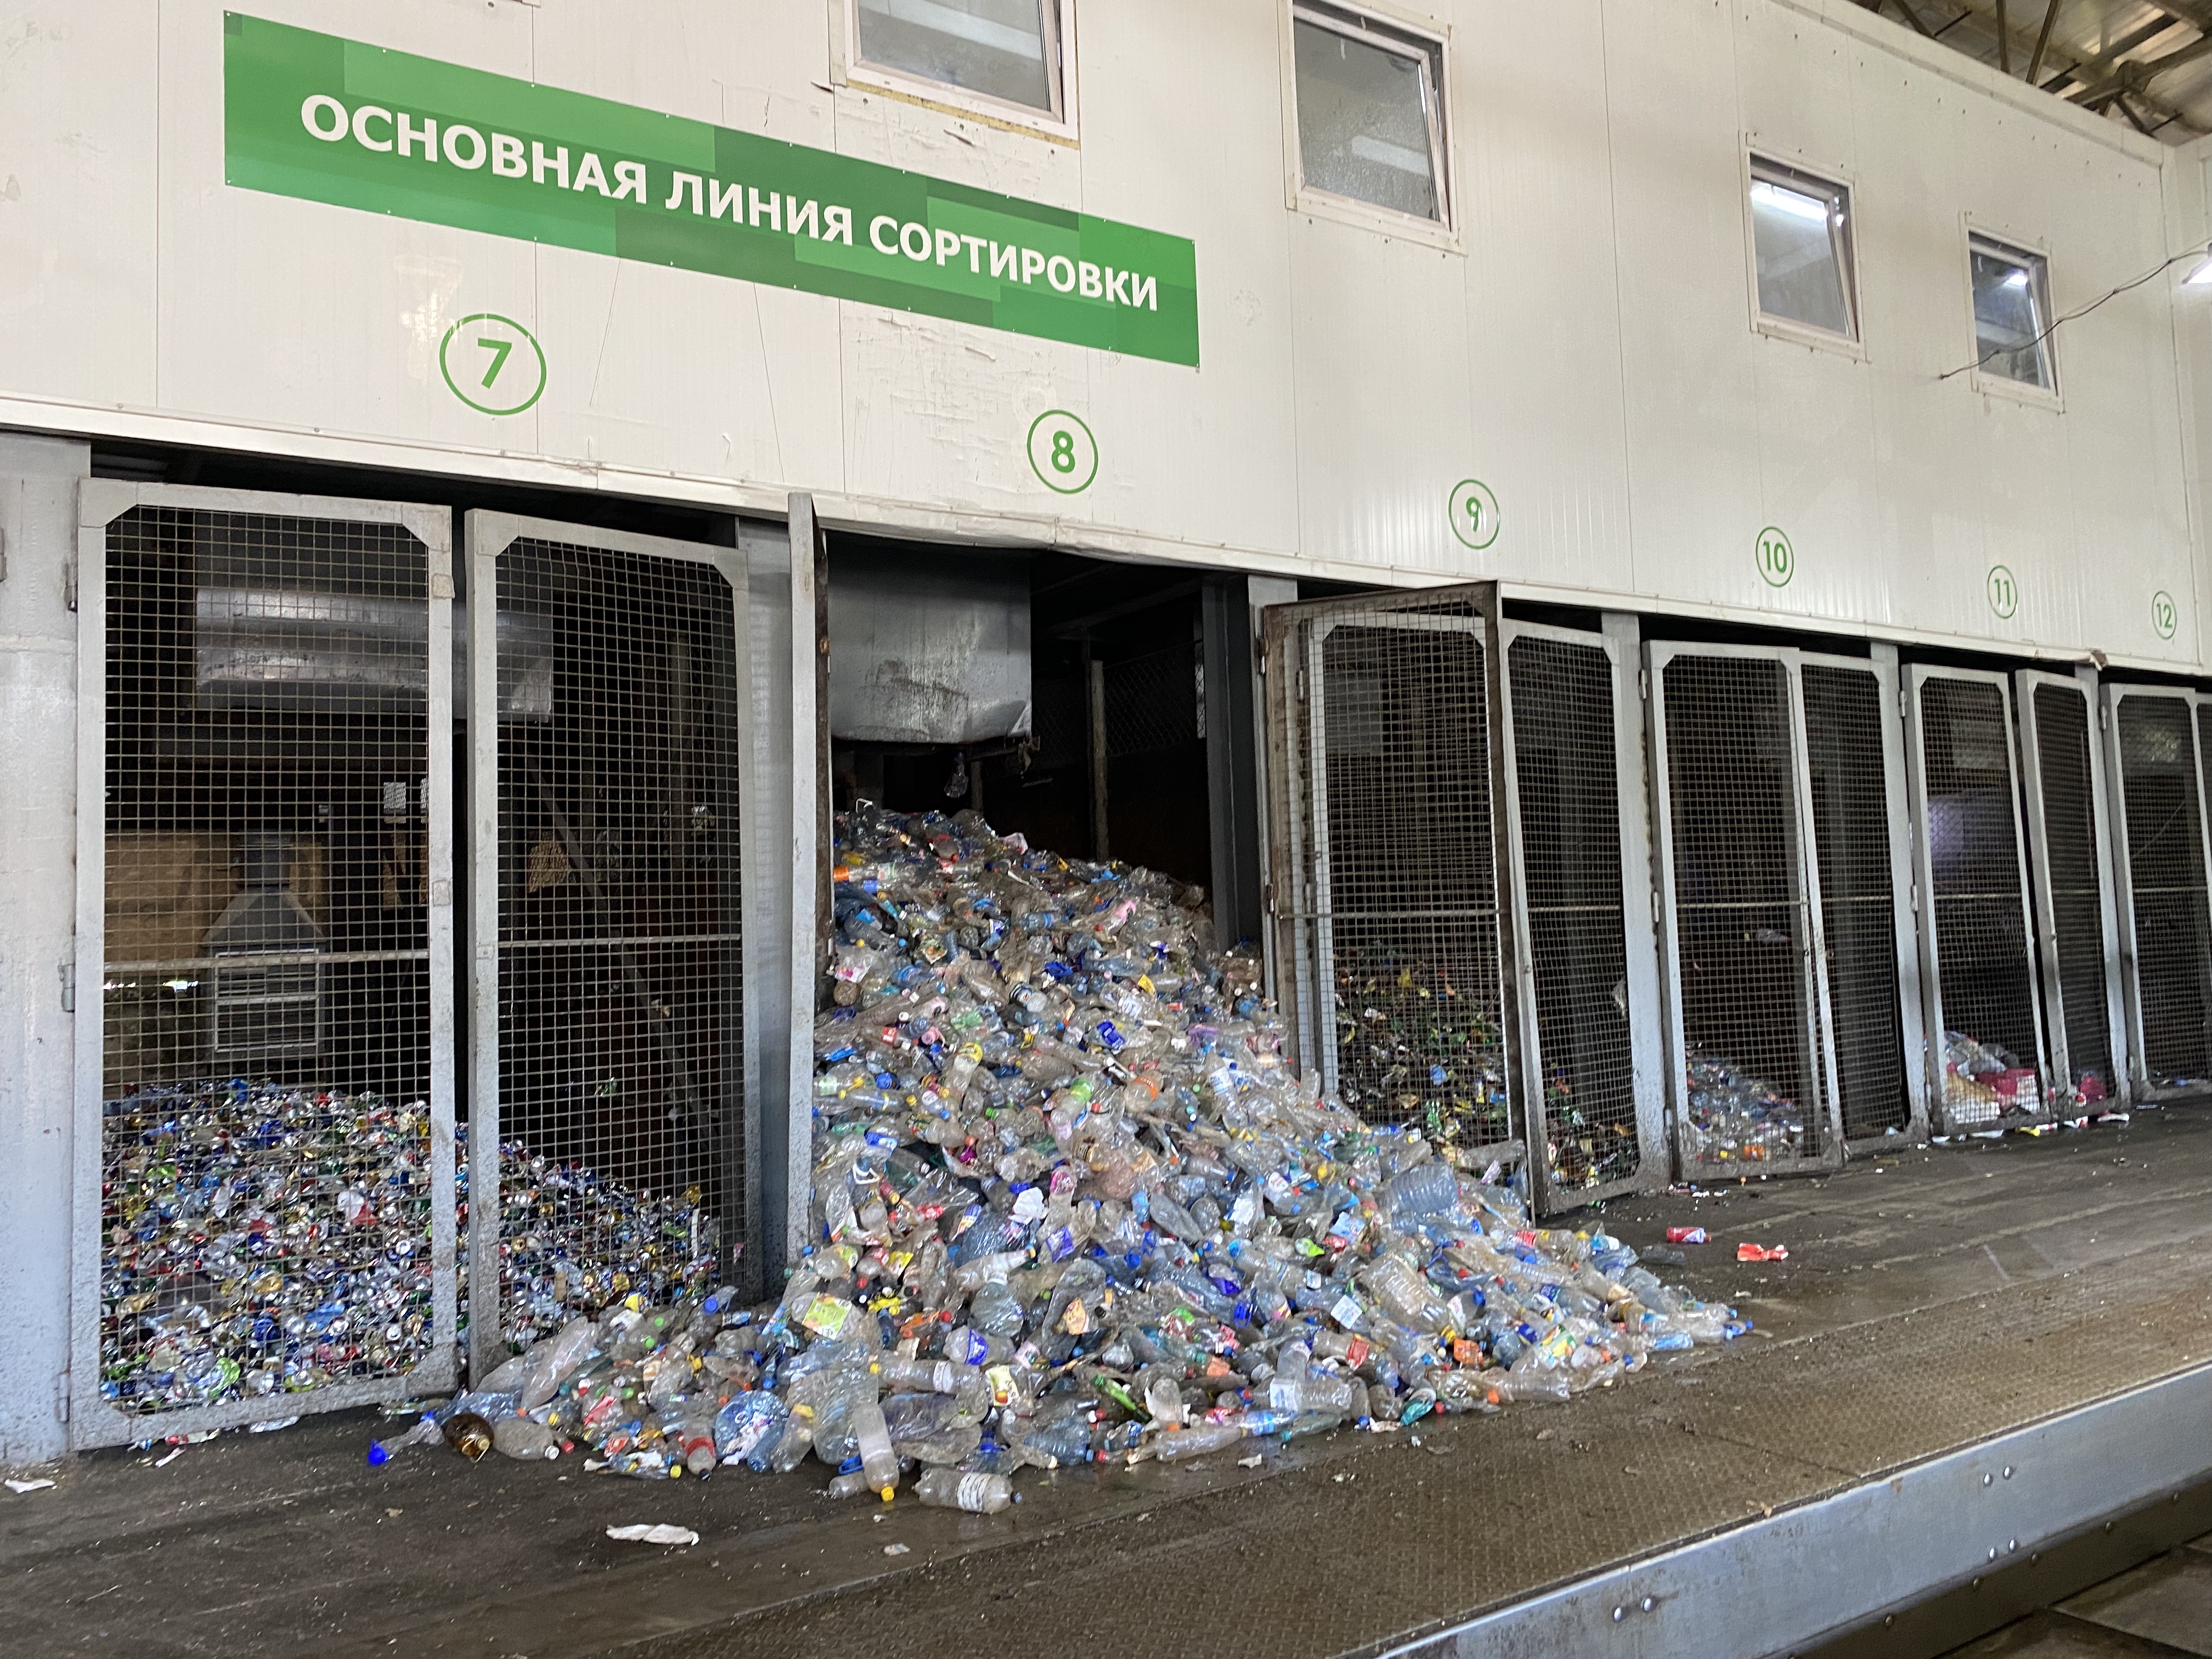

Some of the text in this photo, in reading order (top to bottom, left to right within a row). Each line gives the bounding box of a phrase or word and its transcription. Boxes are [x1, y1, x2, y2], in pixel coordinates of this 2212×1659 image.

[301, 94, 1158, 312] ОСНОВНАЯ ЛИНИЯ СОРТИРОВКИ
[477, 337, 512, 389] 7
[1051, 430, 1076, 474] 8
[1465, 496, 1482, 532] 9
[1763, 540, 1788, 574] 10
[1994, 578, 2011, 607] 11
[2156, 603, 2173, 628] 12
